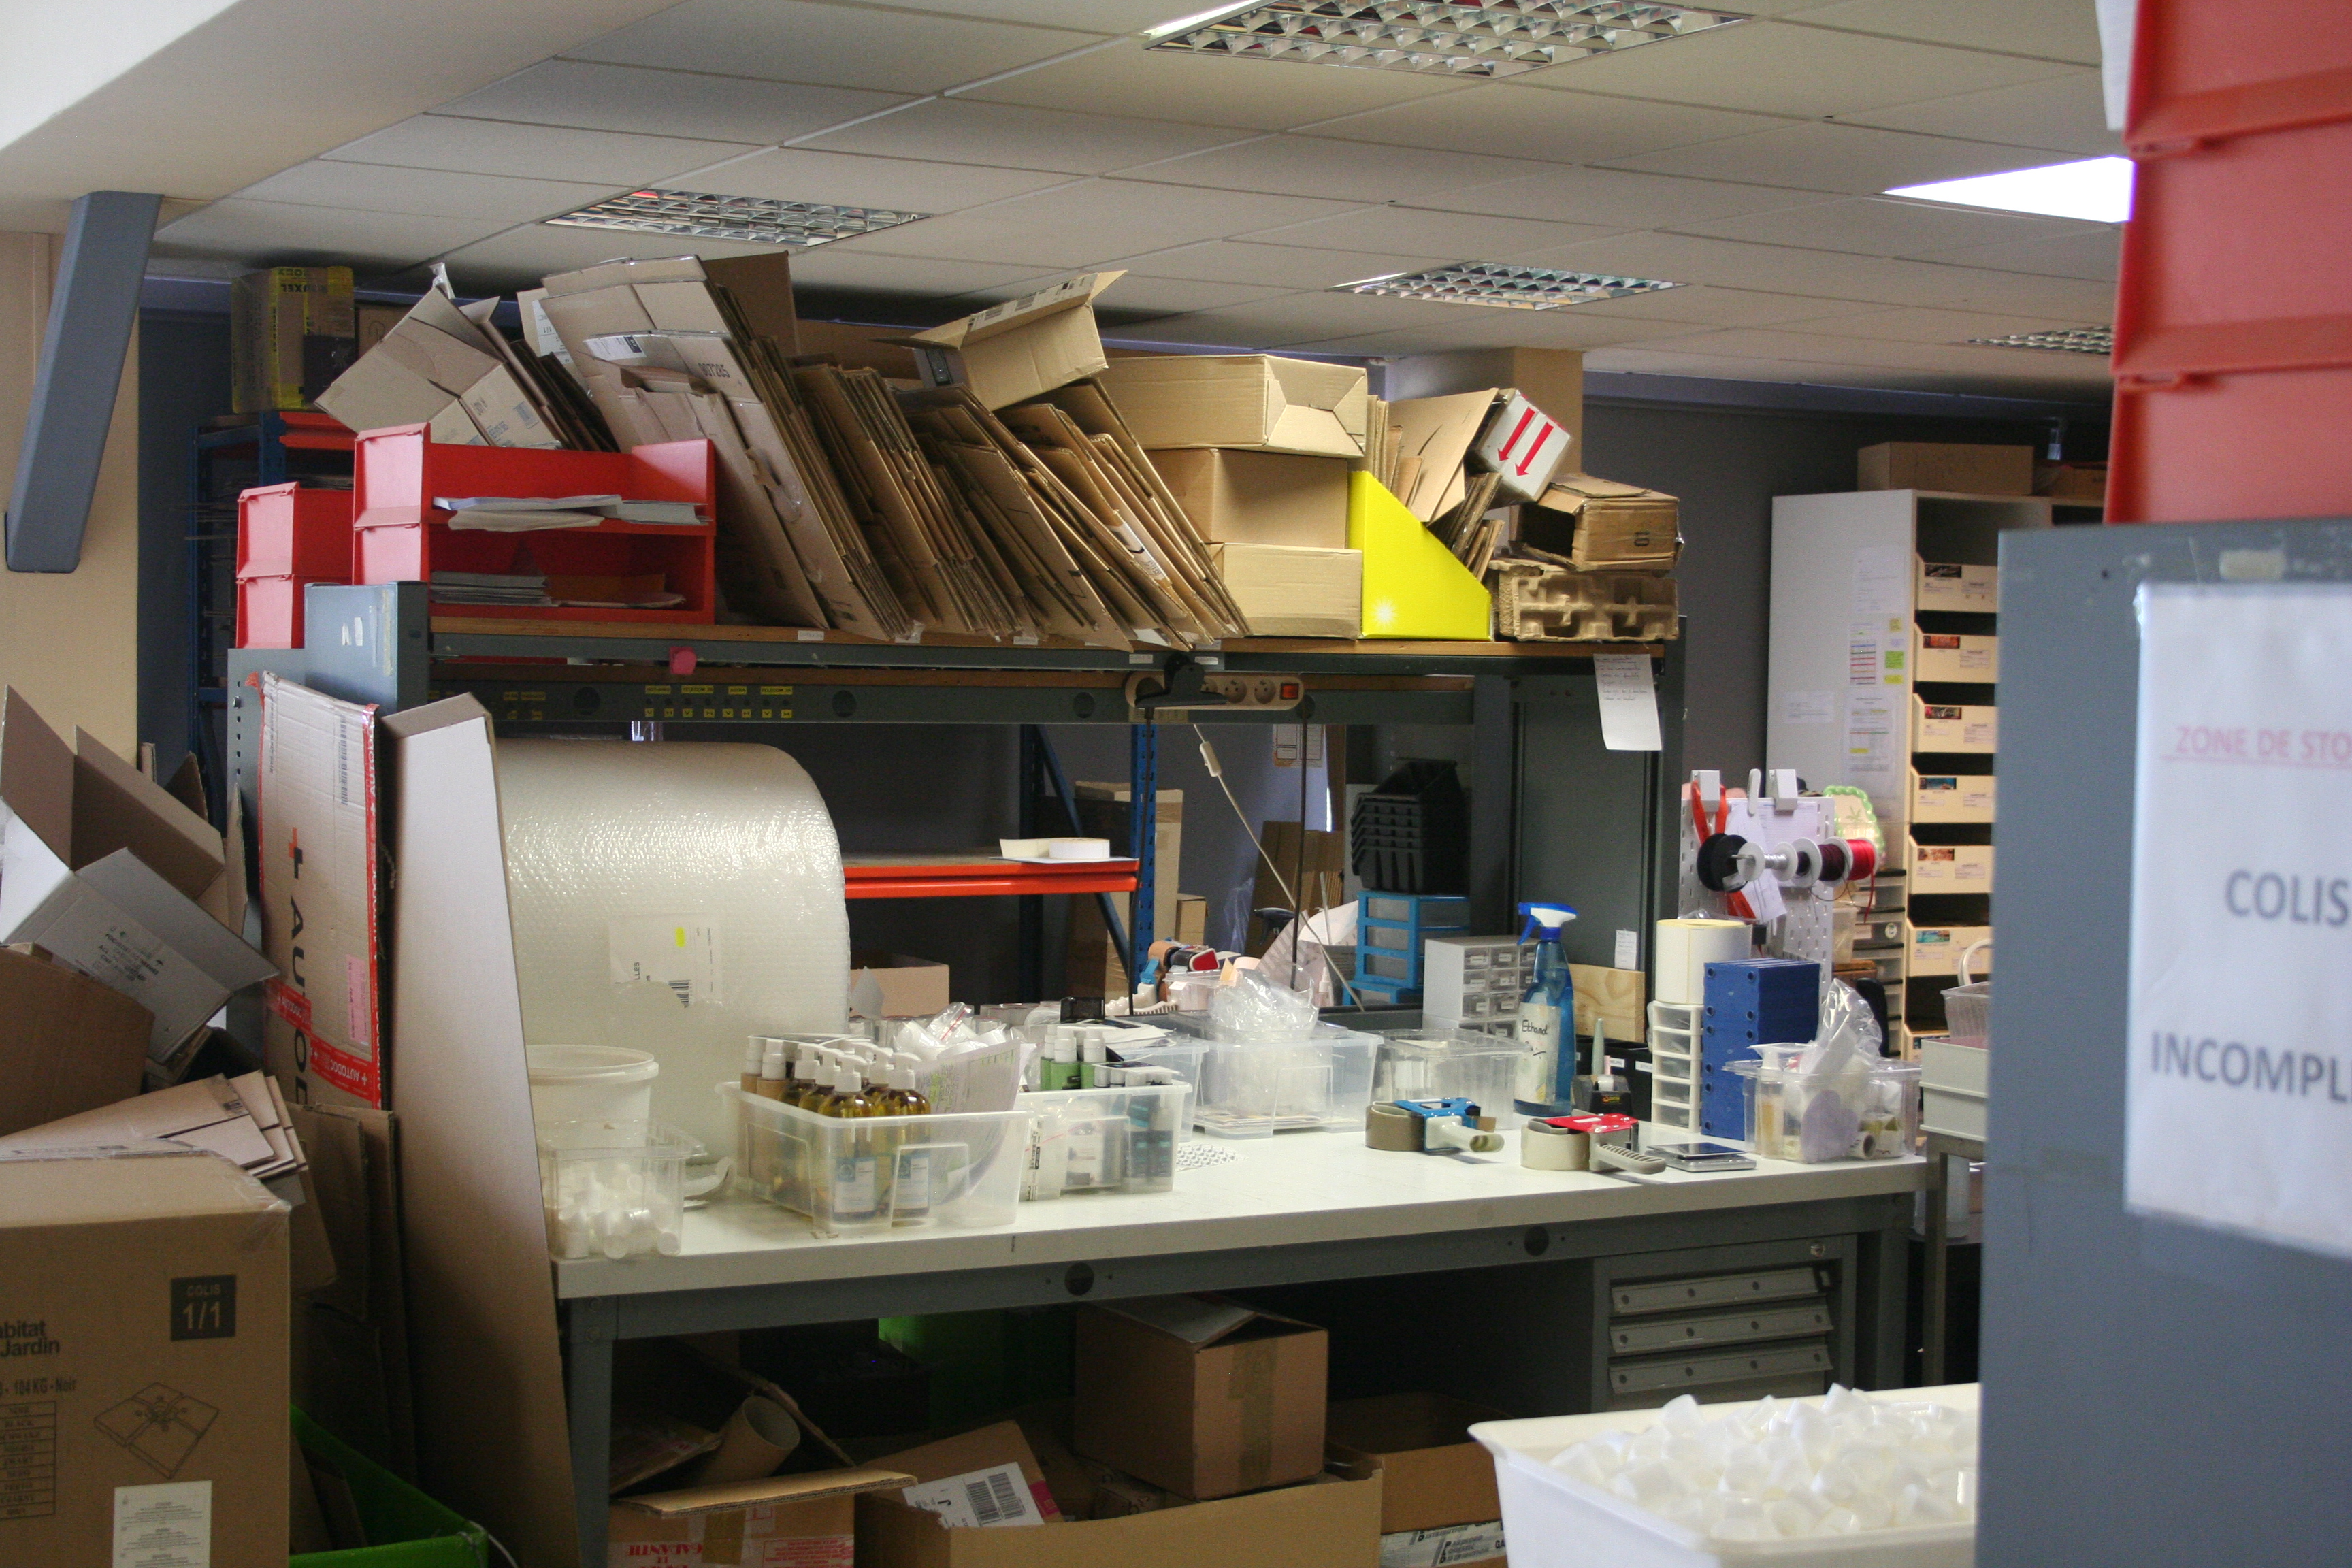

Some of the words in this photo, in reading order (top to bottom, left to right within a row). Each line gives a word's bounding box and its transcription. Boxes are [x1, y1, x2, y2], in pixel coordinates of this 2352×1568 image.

[2177, 725, 2247, 755] ZONE
[2257, 729, 2291, 757] DE
[2225, 868, 2350, 928] COLIS
[2150, 1030, 2352, 1104] INCOMPL
[182, 1301, 222, 1329] 1/1
[0, 1337, 61, 1357] Jardin
